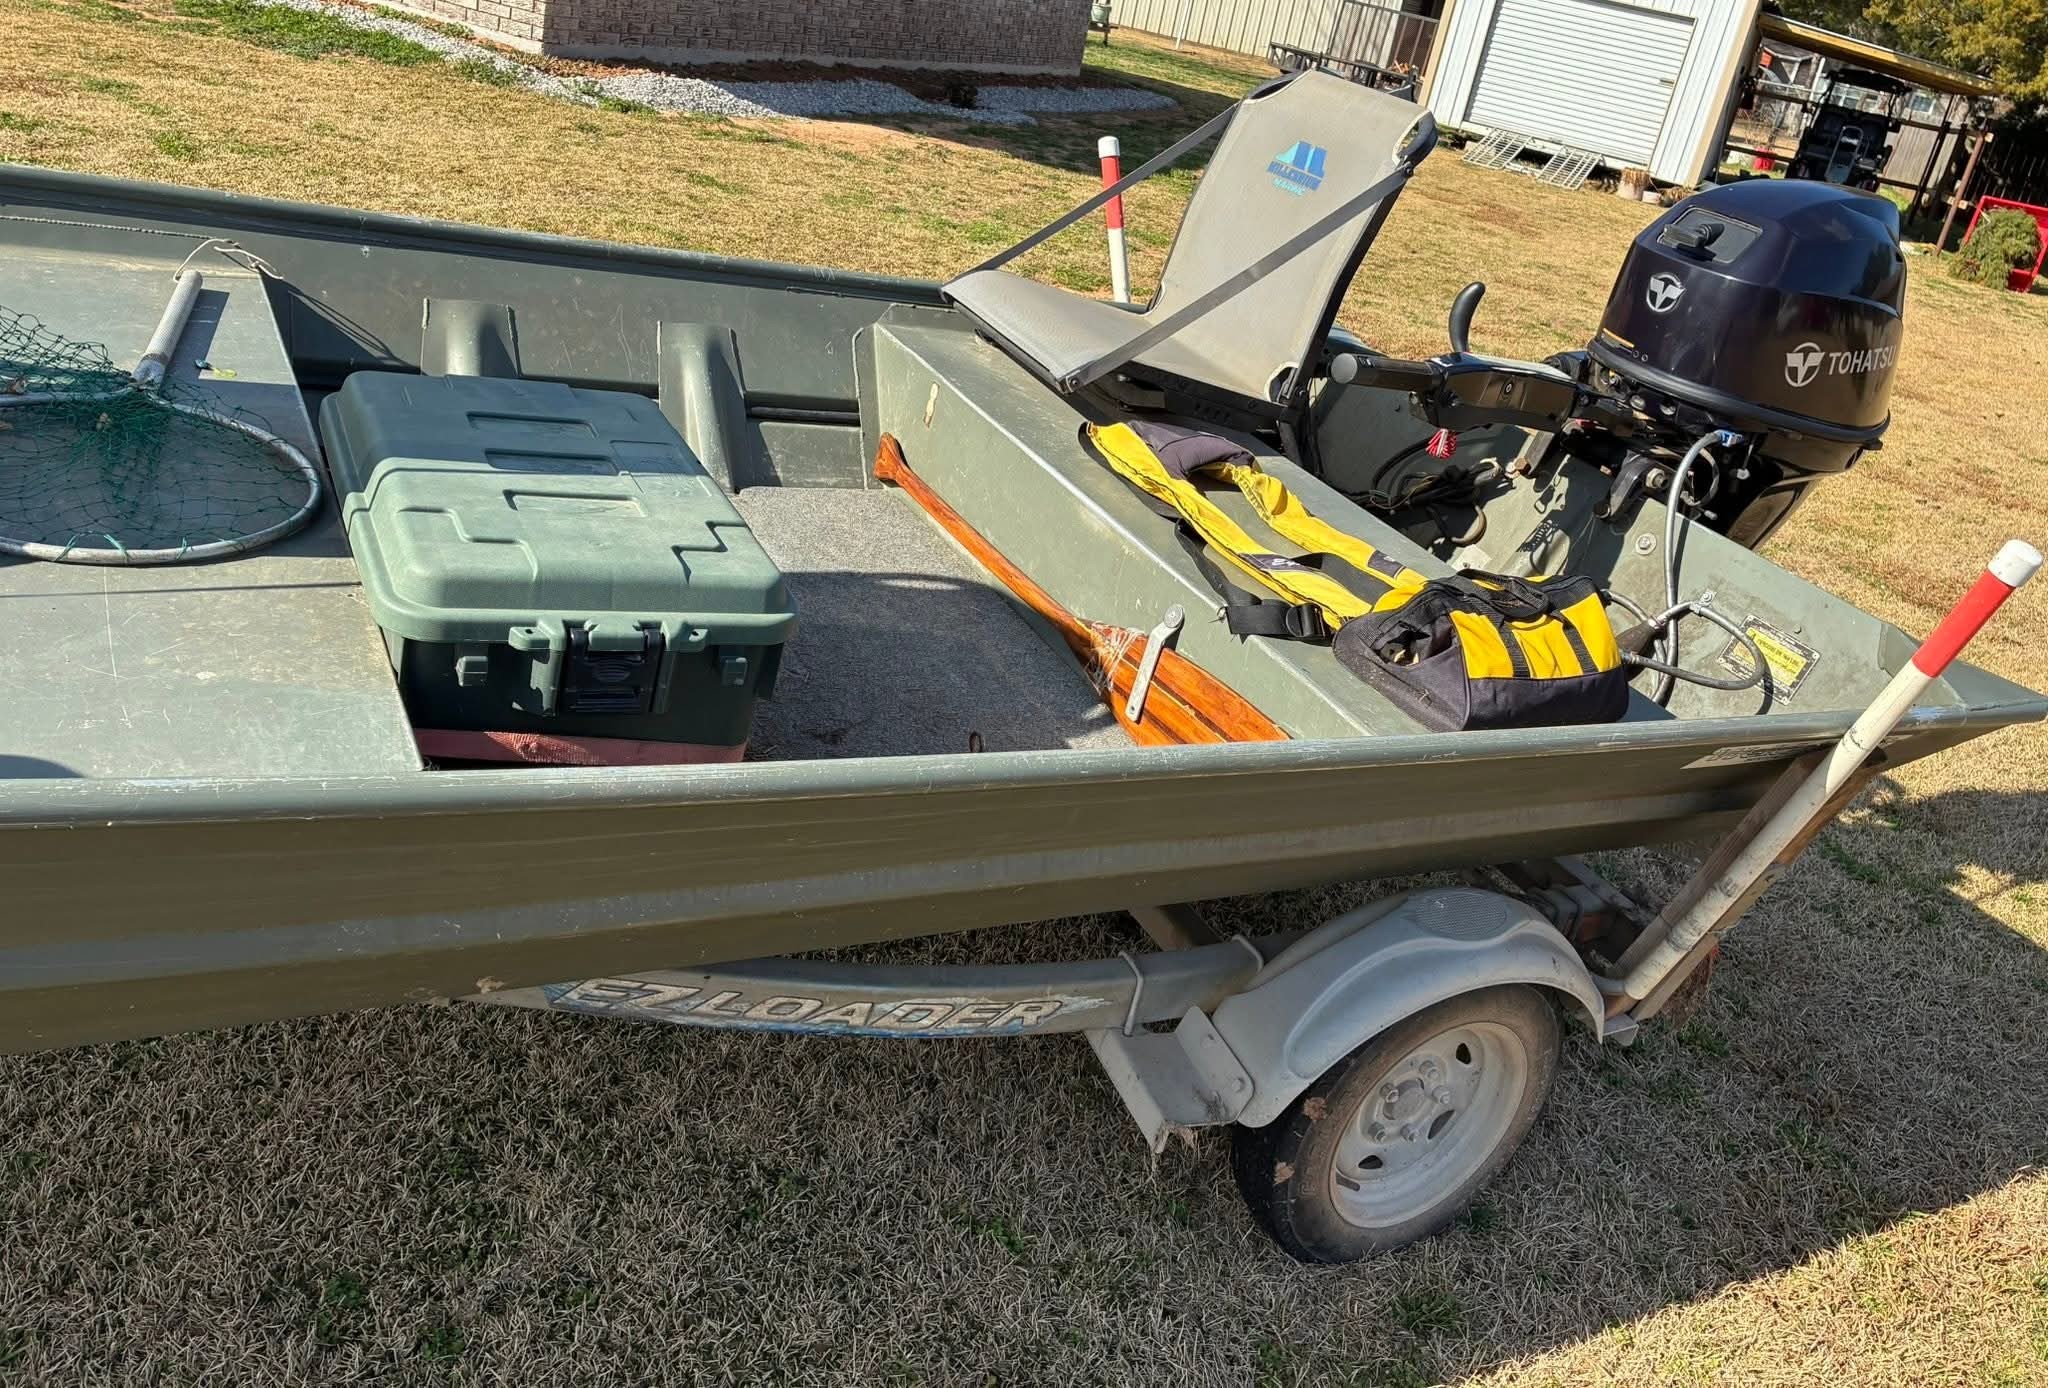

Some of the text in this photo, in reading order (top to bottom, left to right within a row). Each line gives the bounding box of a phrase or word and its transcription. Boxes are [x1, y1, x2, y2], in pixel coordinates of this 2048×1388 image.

[1828, 345, 1897, 375] TOHATSU
[550, 977, 1064, 1031] EZ LOADER
